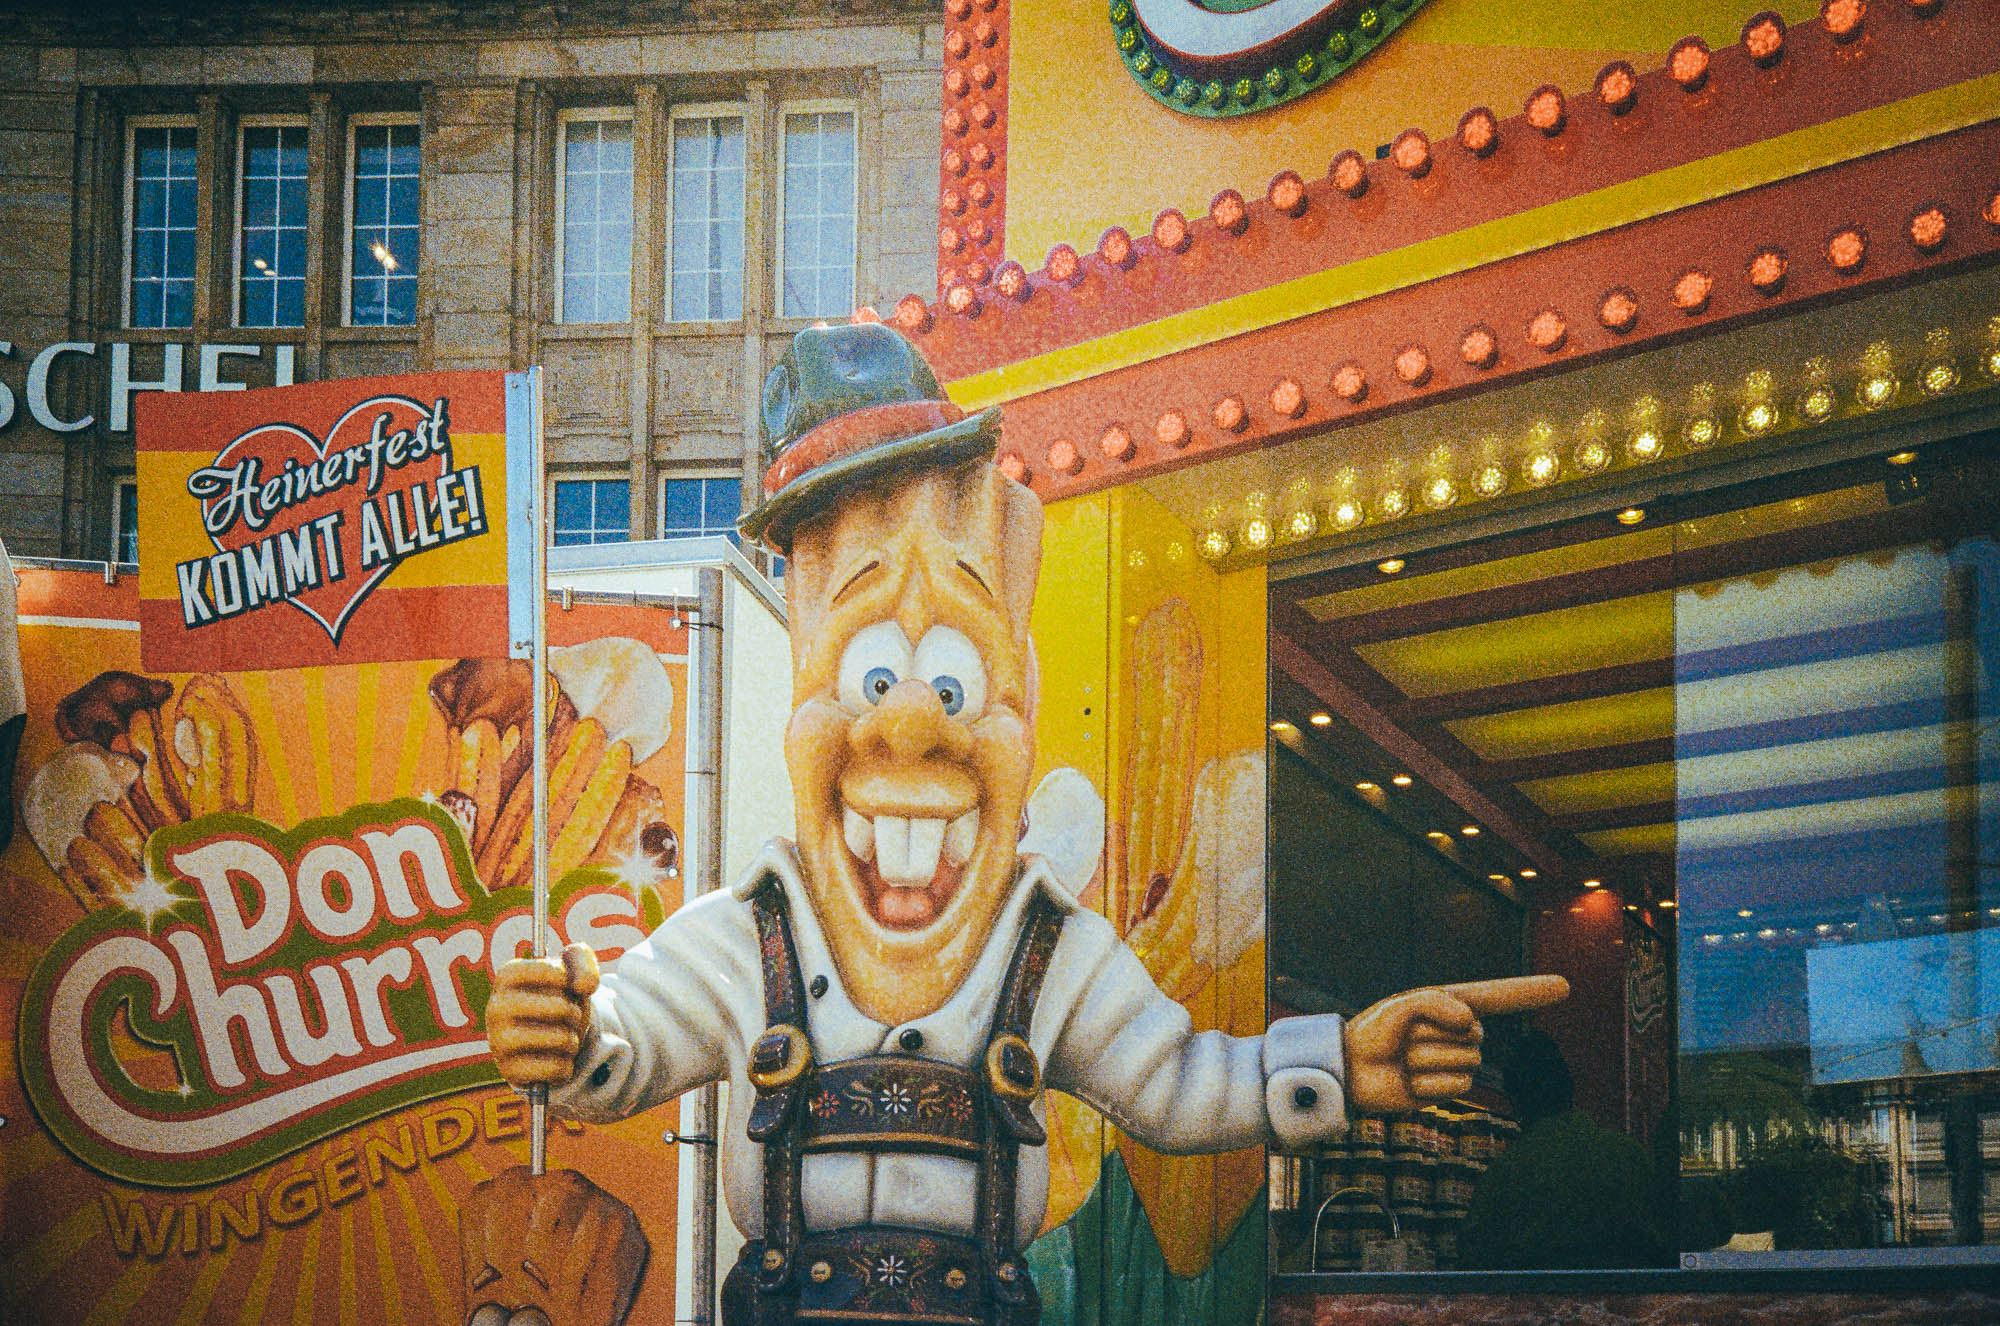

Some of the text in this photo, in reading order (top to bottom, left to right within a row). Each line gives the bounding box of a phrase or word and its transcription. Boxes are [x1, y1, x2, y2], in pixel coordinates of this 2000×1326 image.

[188, 398, 448, 532] Heinerfest
[177, 466, 486, 627] KOMMT ALLE!
[173, 824, 464, 965] Don
[104, 1094, 584, 1262] WINGENDE
